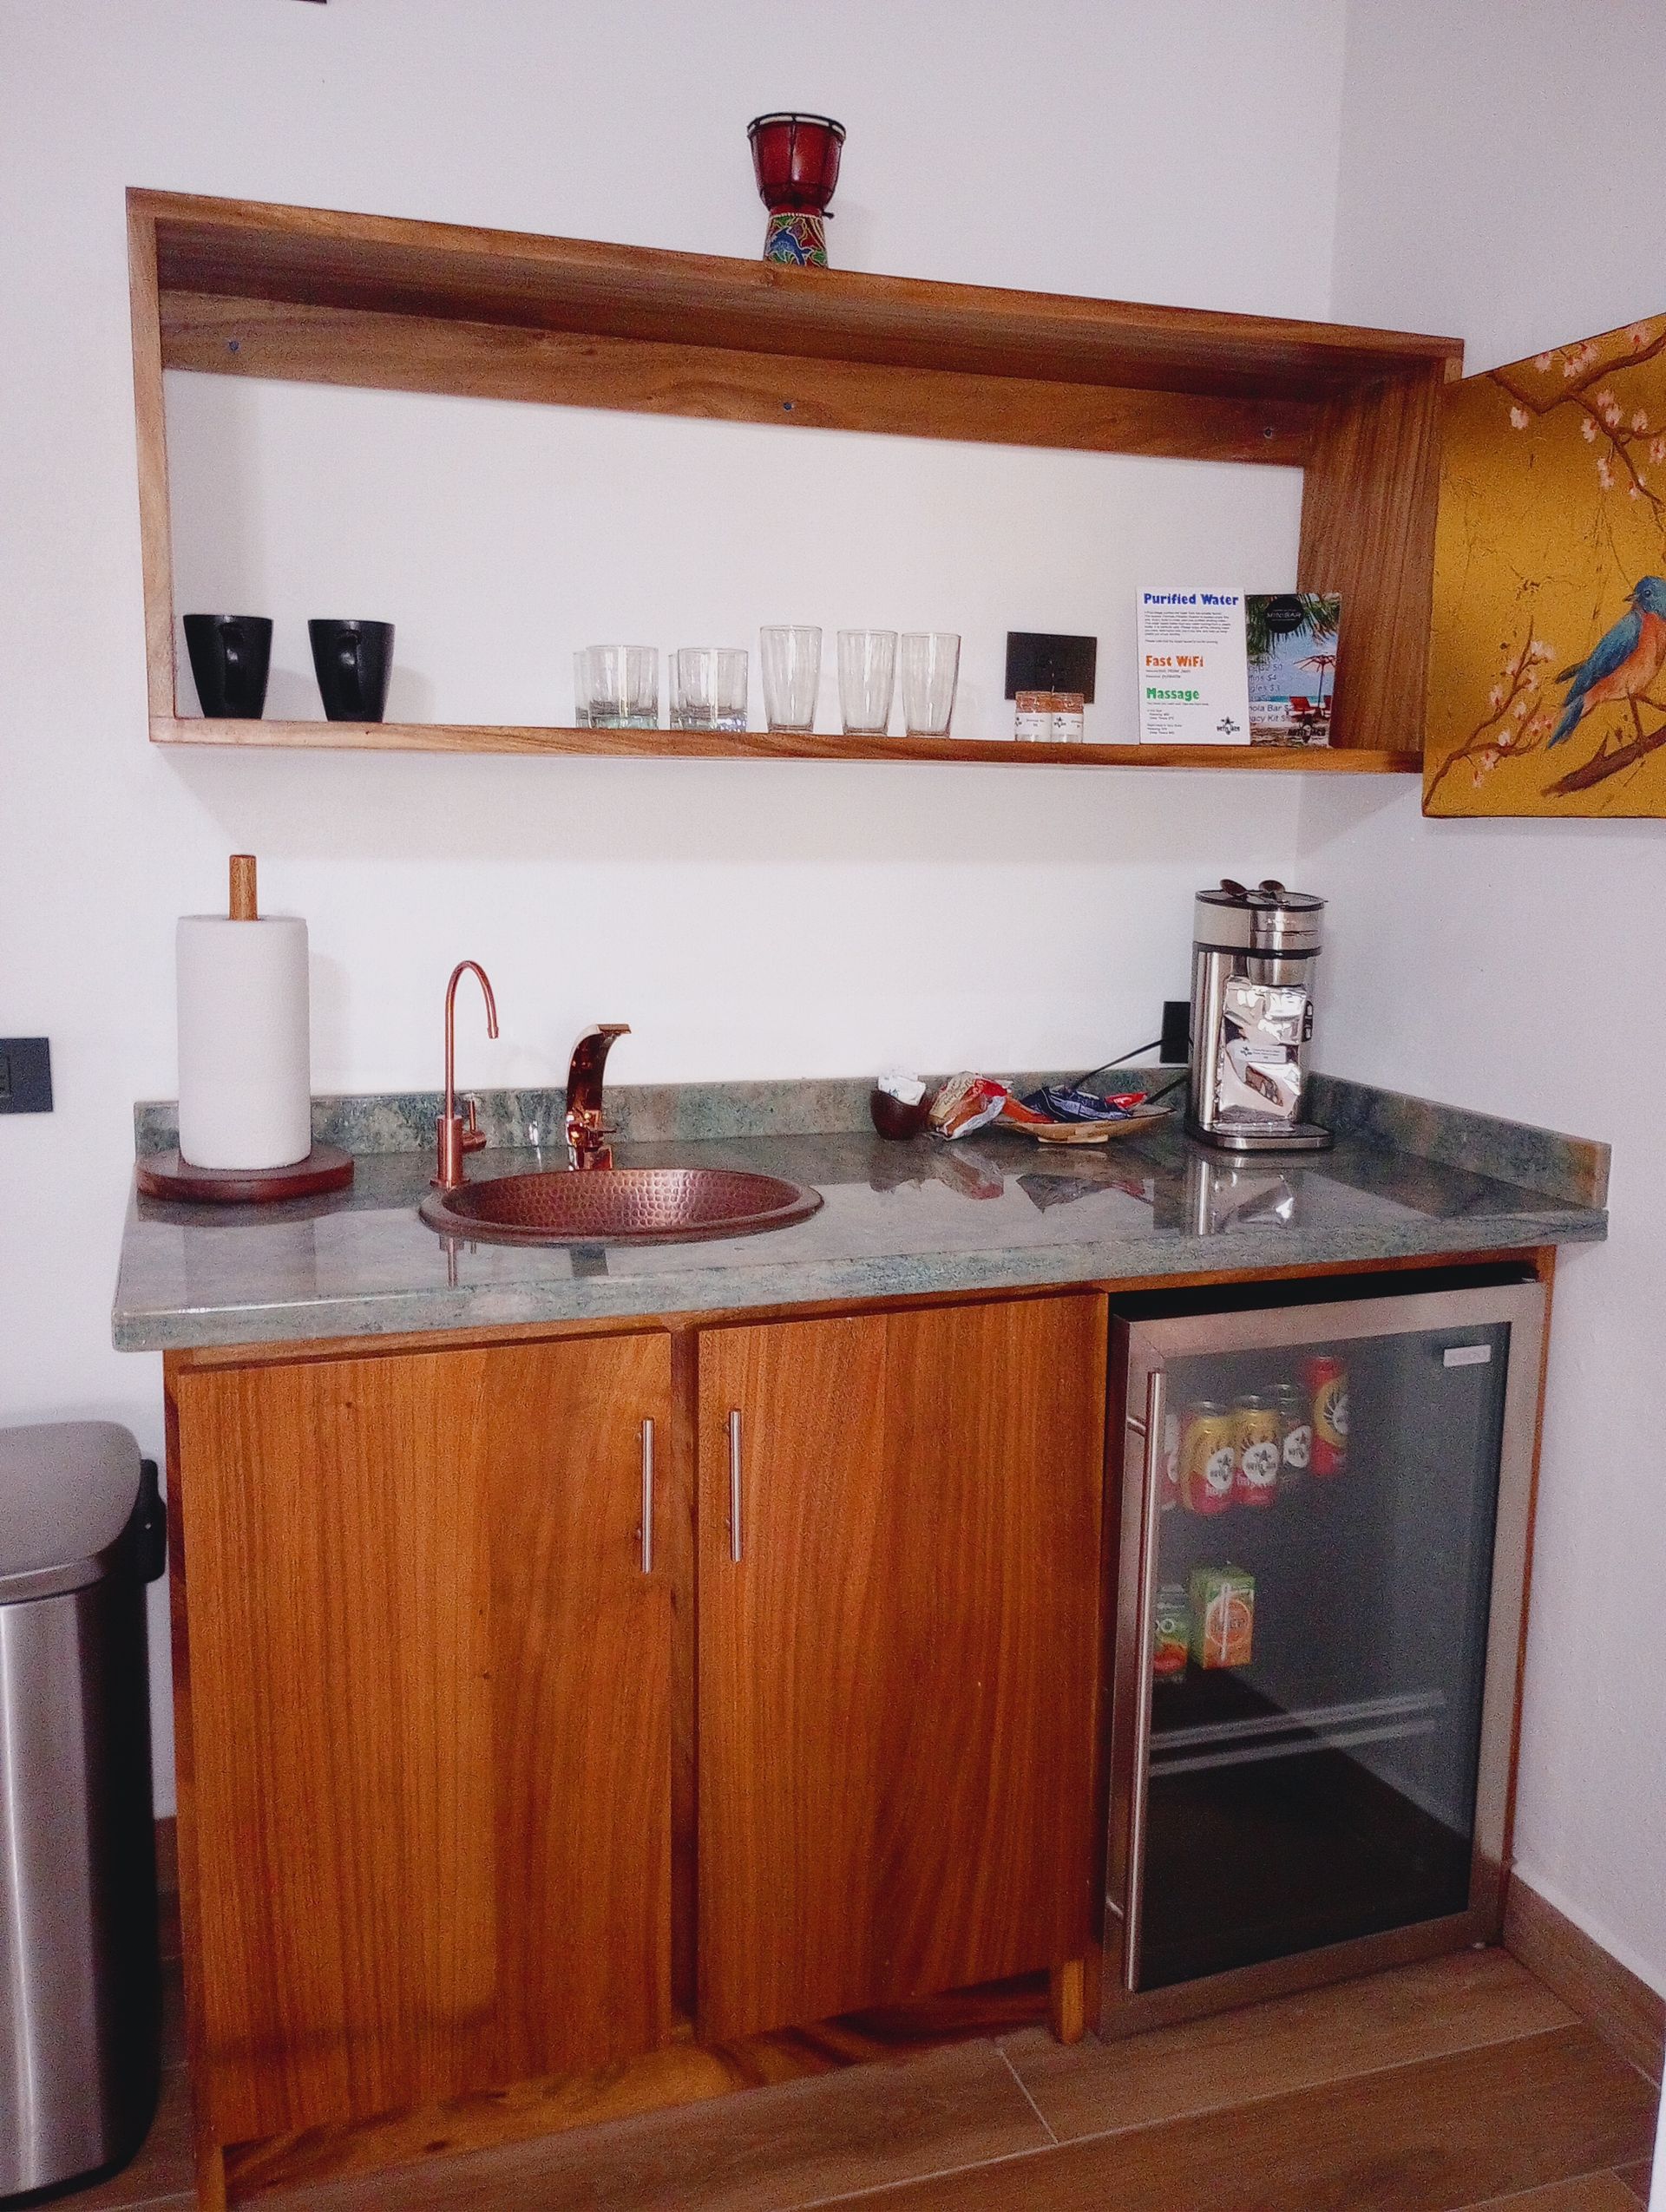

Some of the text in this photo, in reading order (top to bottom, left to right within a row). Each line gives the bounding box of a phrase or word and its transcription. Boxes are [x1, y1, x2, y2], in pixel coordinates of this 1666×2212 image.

[1144, 593, 1239, 606] Purified Water
[1145, 655, 1204, 667] Fast WiFi
[1146, 687, 1200, 702] Massage
